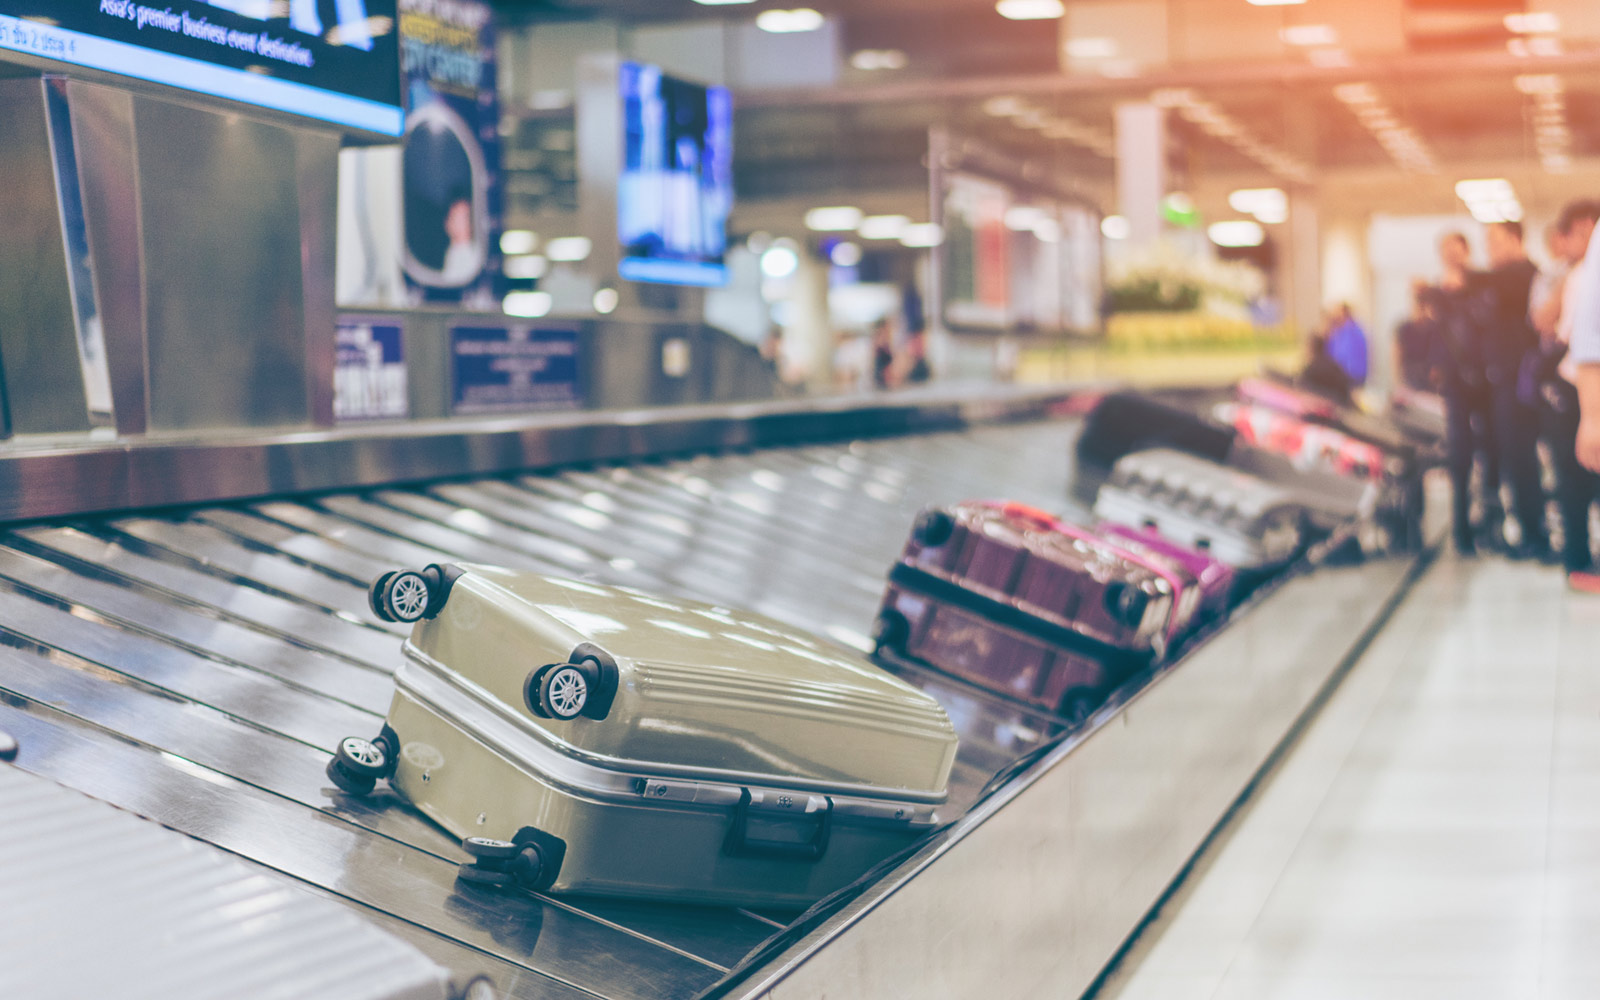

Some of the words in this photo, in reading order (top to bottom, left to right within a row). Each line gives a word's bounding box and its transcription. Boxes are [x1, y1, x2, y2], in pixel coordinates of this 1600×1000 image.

[100, 0, 136, 21] Asia's
[137, 6, 181, 33] premier
[181, 10, 228, 45] business
[227, 29, 259, 54] event
